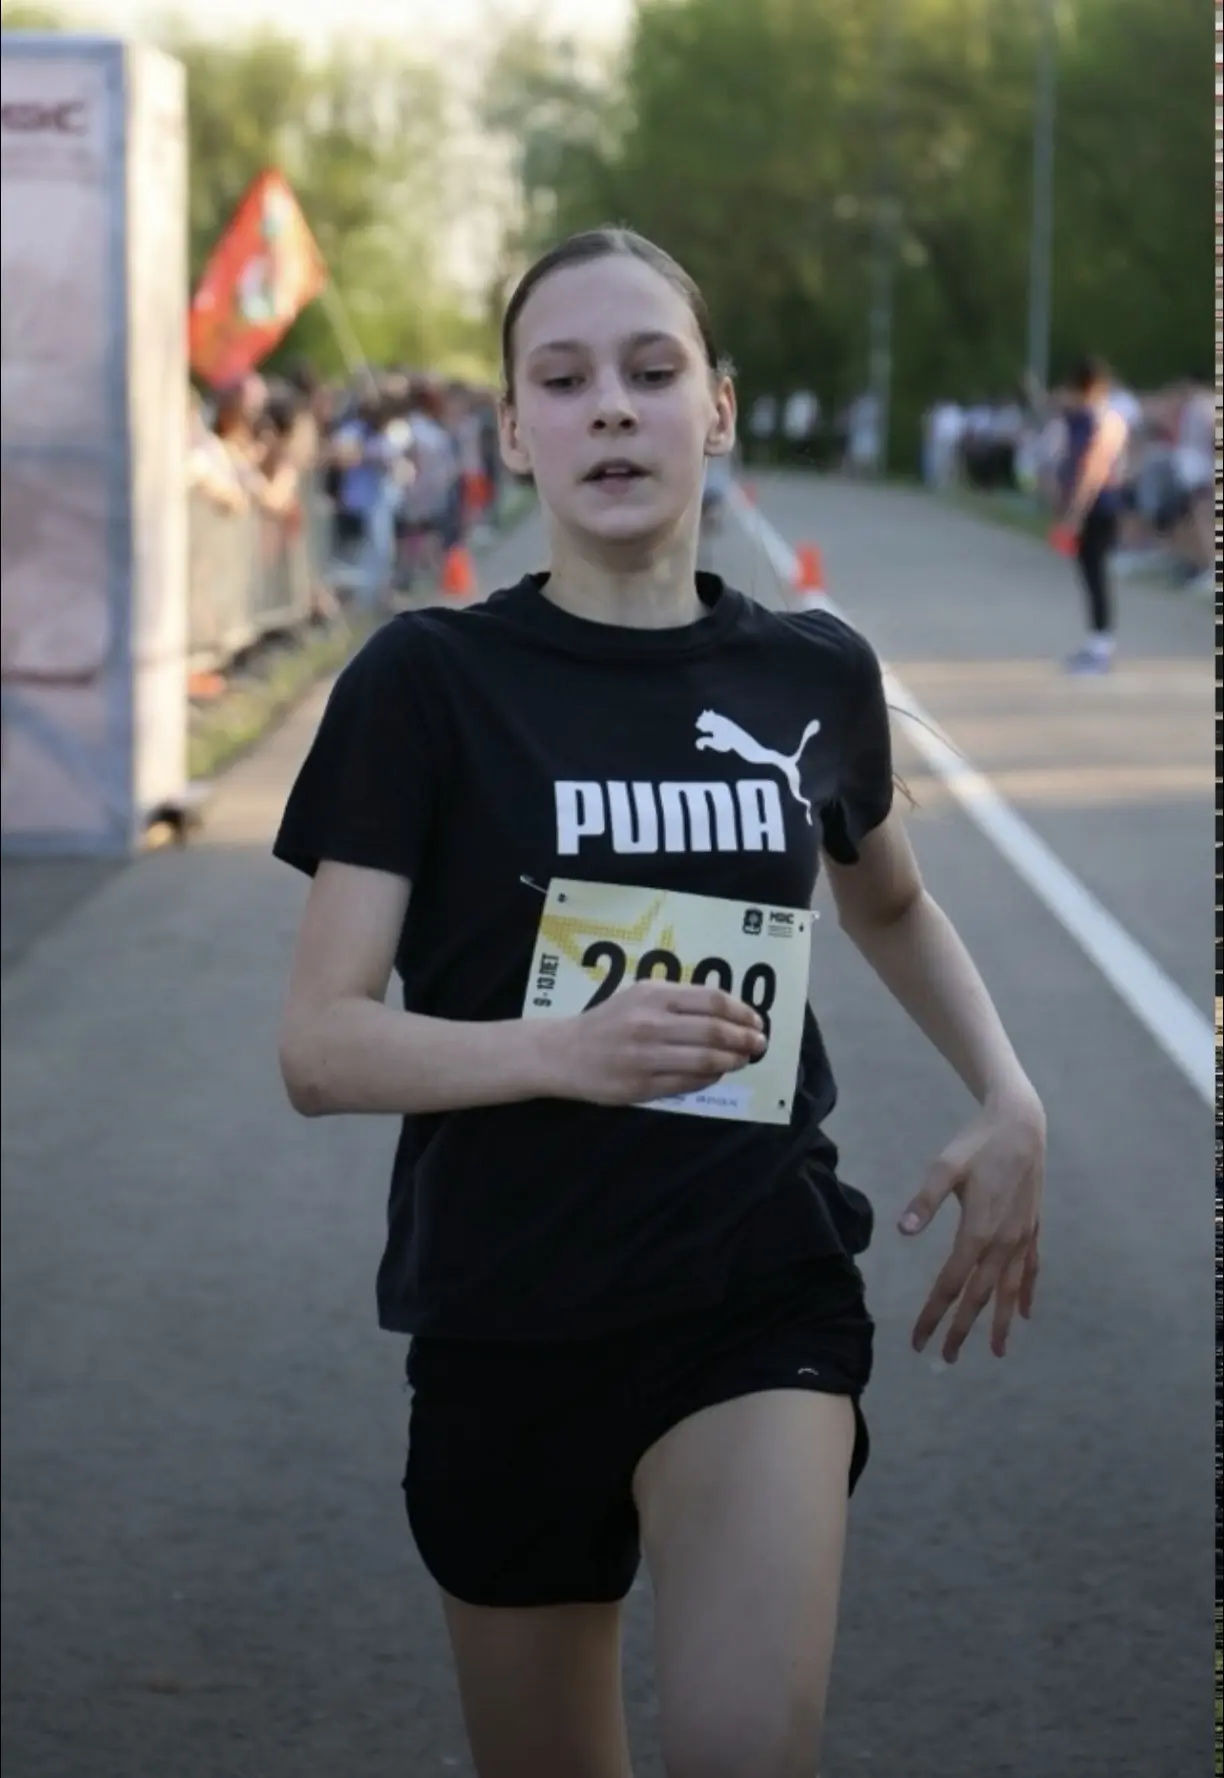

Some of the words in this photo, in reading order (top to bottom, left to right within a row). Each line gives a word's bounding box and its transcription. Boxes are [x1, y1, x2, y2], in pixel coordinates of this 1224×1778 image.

[554, 779, 786, 855] PUMA
[539, 953, 559, 976] ЛЕТ
[537, 976, 555, 990] 13
